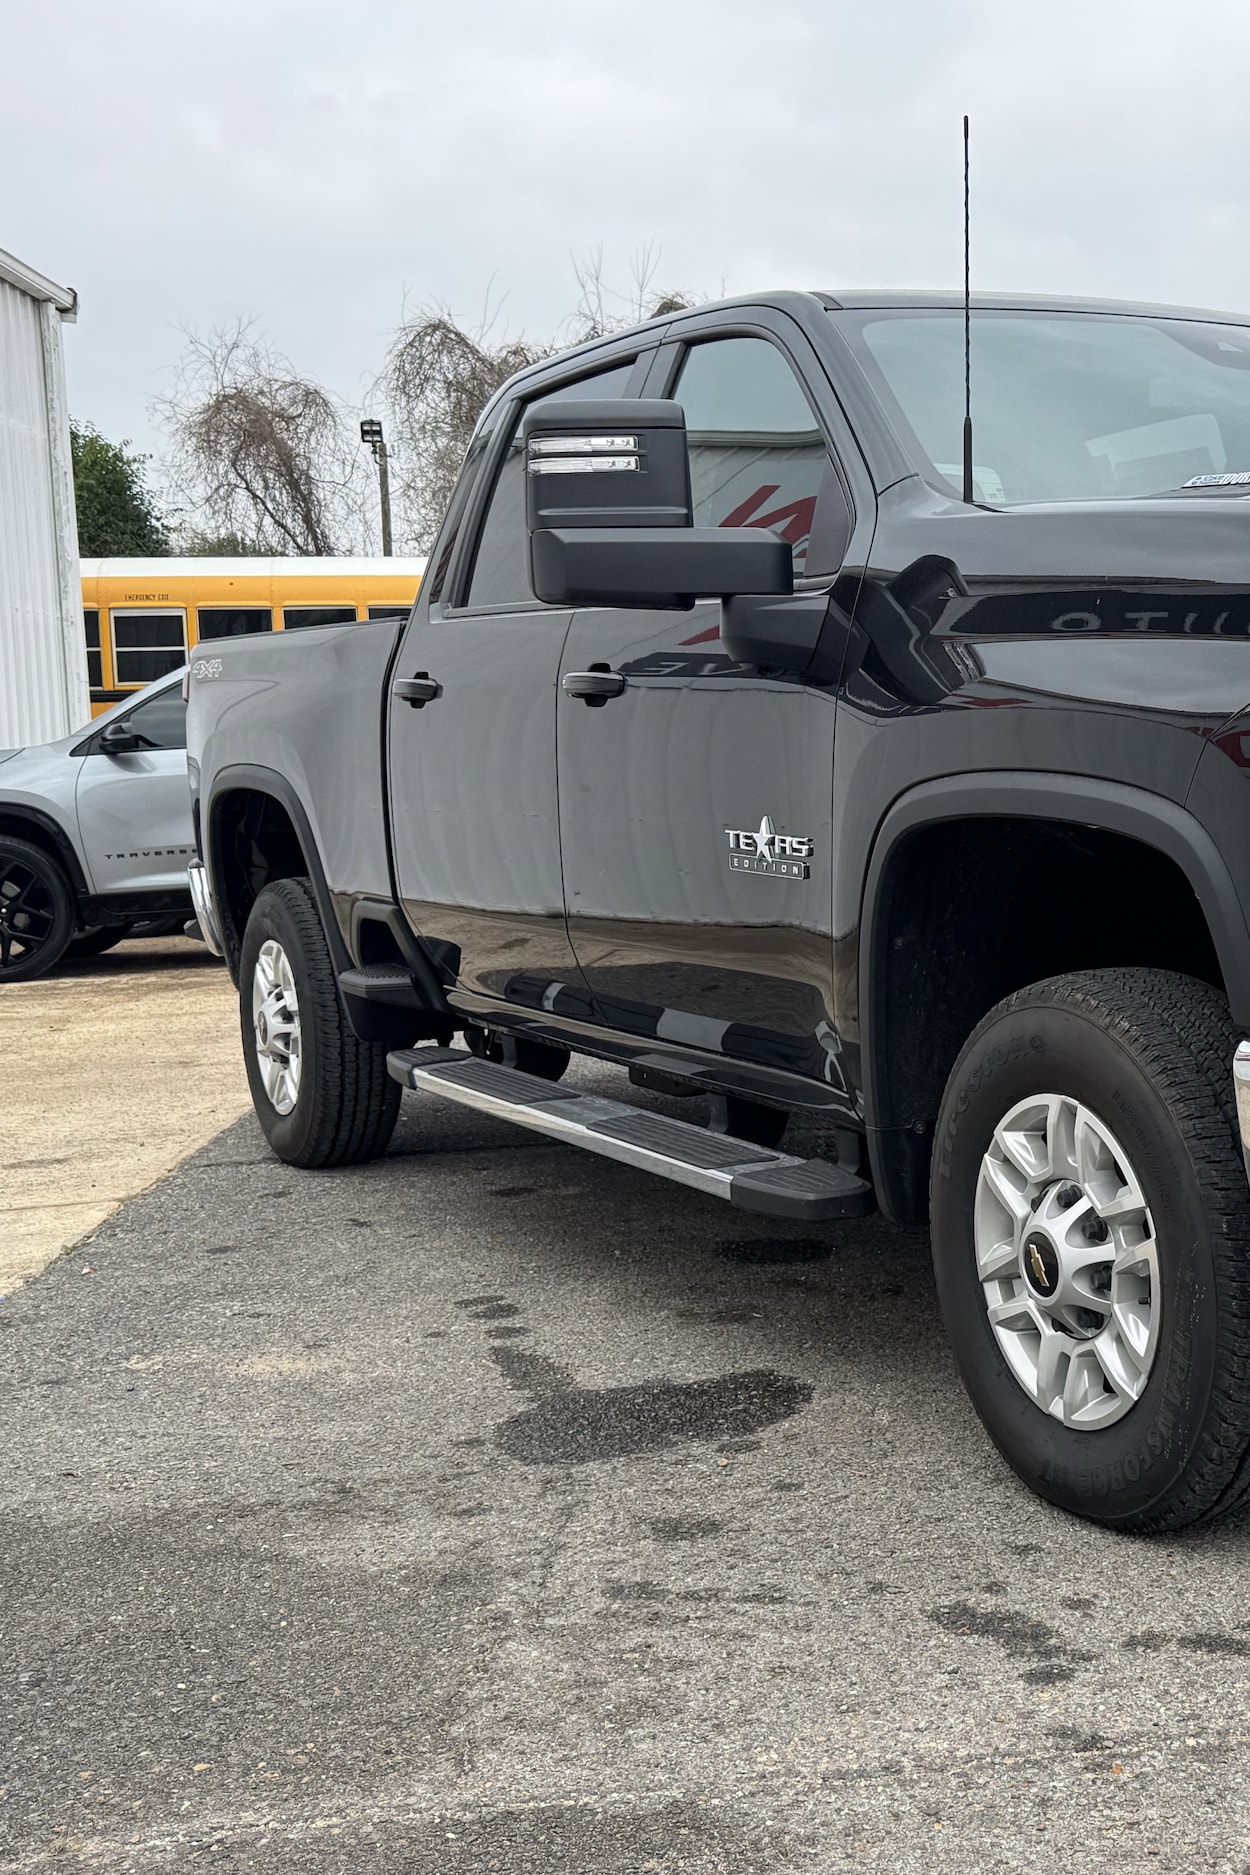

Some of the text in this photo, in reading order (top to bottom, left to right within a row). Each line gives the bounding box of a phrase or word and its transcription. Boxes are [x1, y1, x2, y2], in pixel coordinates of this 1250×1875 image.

[125, 593, 169, 601] EMERGENCY EXIT
[725, 819, 812, 861] TEXAS
[733, 858, 799, 875] EDITION
